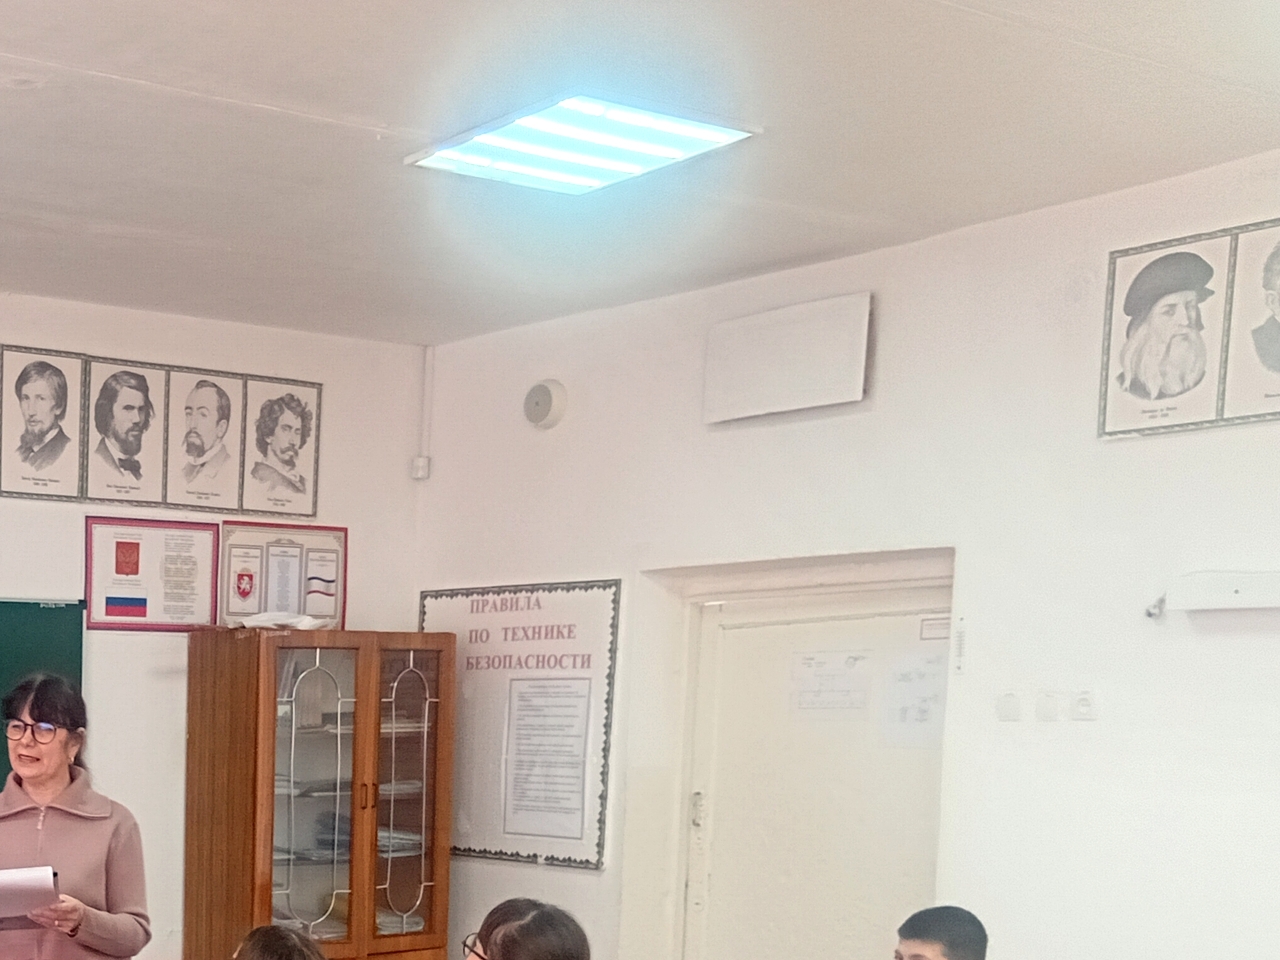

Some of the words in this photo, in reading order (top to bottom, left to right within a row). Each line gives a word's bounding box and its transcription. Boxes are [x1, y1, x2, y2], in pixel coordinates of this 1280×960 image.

[470, 596, 542, 613] ПРАВИЛА
[469, 628, 490, 644] ПО
[502, 624, 577, 641] ТЕХНИКЕ
[465, 654, 592, 670] БЕЗОПАСНОСТИ
